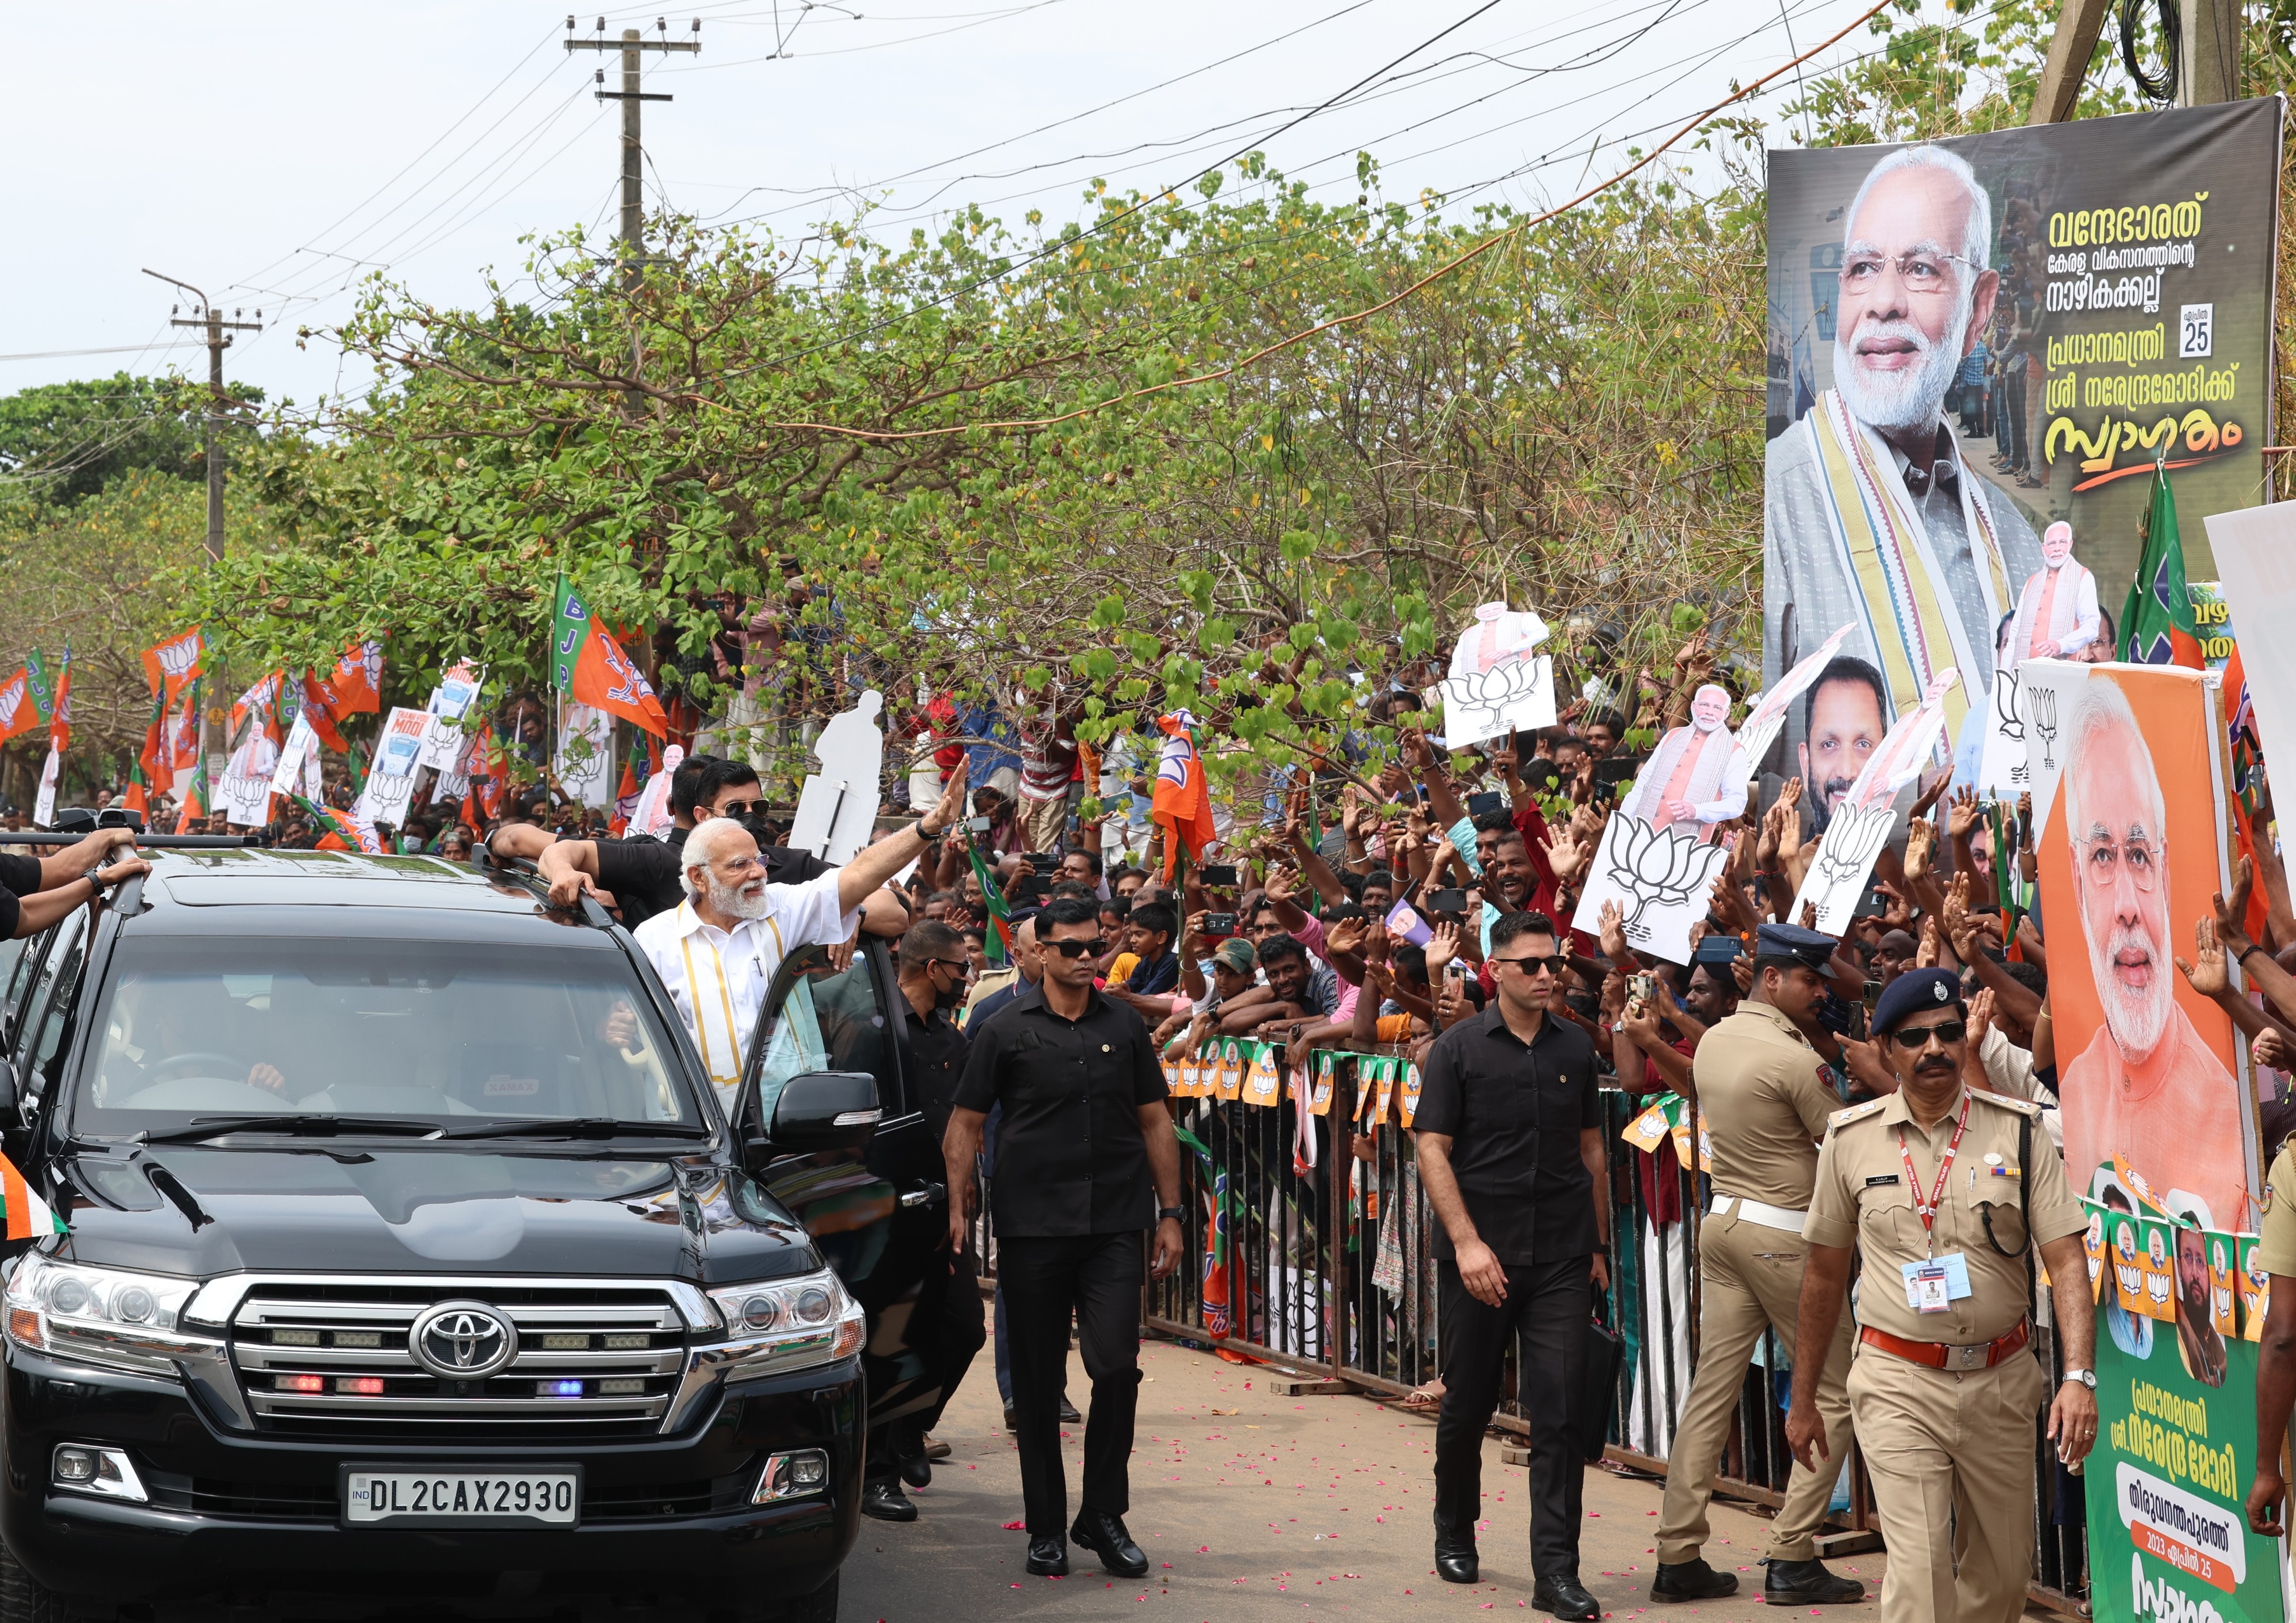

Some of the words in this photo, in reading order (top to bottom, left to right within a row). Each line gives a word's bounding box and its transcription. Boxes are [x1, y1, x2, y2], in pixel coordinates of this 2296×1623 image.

[2049, 191, 2209, 248] വന്ദേഭാരത്
[2048, 252, 2087, 276] കേരള
[2046, 267, 2165, 314] നാഴികക്കല്ല്
[2046, 322, 2165, 372] പ്രധാനമന്ത്രി
[2184, 322, 2208, 353] 25
[2045, 372, 2076, 415] ശ്രീ
[2085, 362, 2240, 412] നരേന്ദ്രമോദിക്ക്
[2044, 408, 2242, 474] സ്വാഗതം
[390, 718, 425, 737] MODI
[397, 710, 417, 721] THANK
[417, 713, 430, 722] YOU
[1906, 1164, 1915, 1180] POLICE
[1912, 1181, 1921, 1200] KERALA
[1933, 1183, 1942, 1201] KERALA
[1939, 1165, 1948, 1182] POLICE
[2131, 1378, 2208, 1439] പ്രധാനമന്ത്രി
[353, 1490, 369, 1500] IND
[370, 1479, 572, 1512] DL2CAX2930
[2129, 1479, 2229, 1553] തിരുവനന്തപുരത്ത്
[2147, 1531, 2165, 1556] 2023
[2167, 1544, 2199, 1573] ഏപ്രിൽ
[2201, 1557, 2212, 1579] 25
